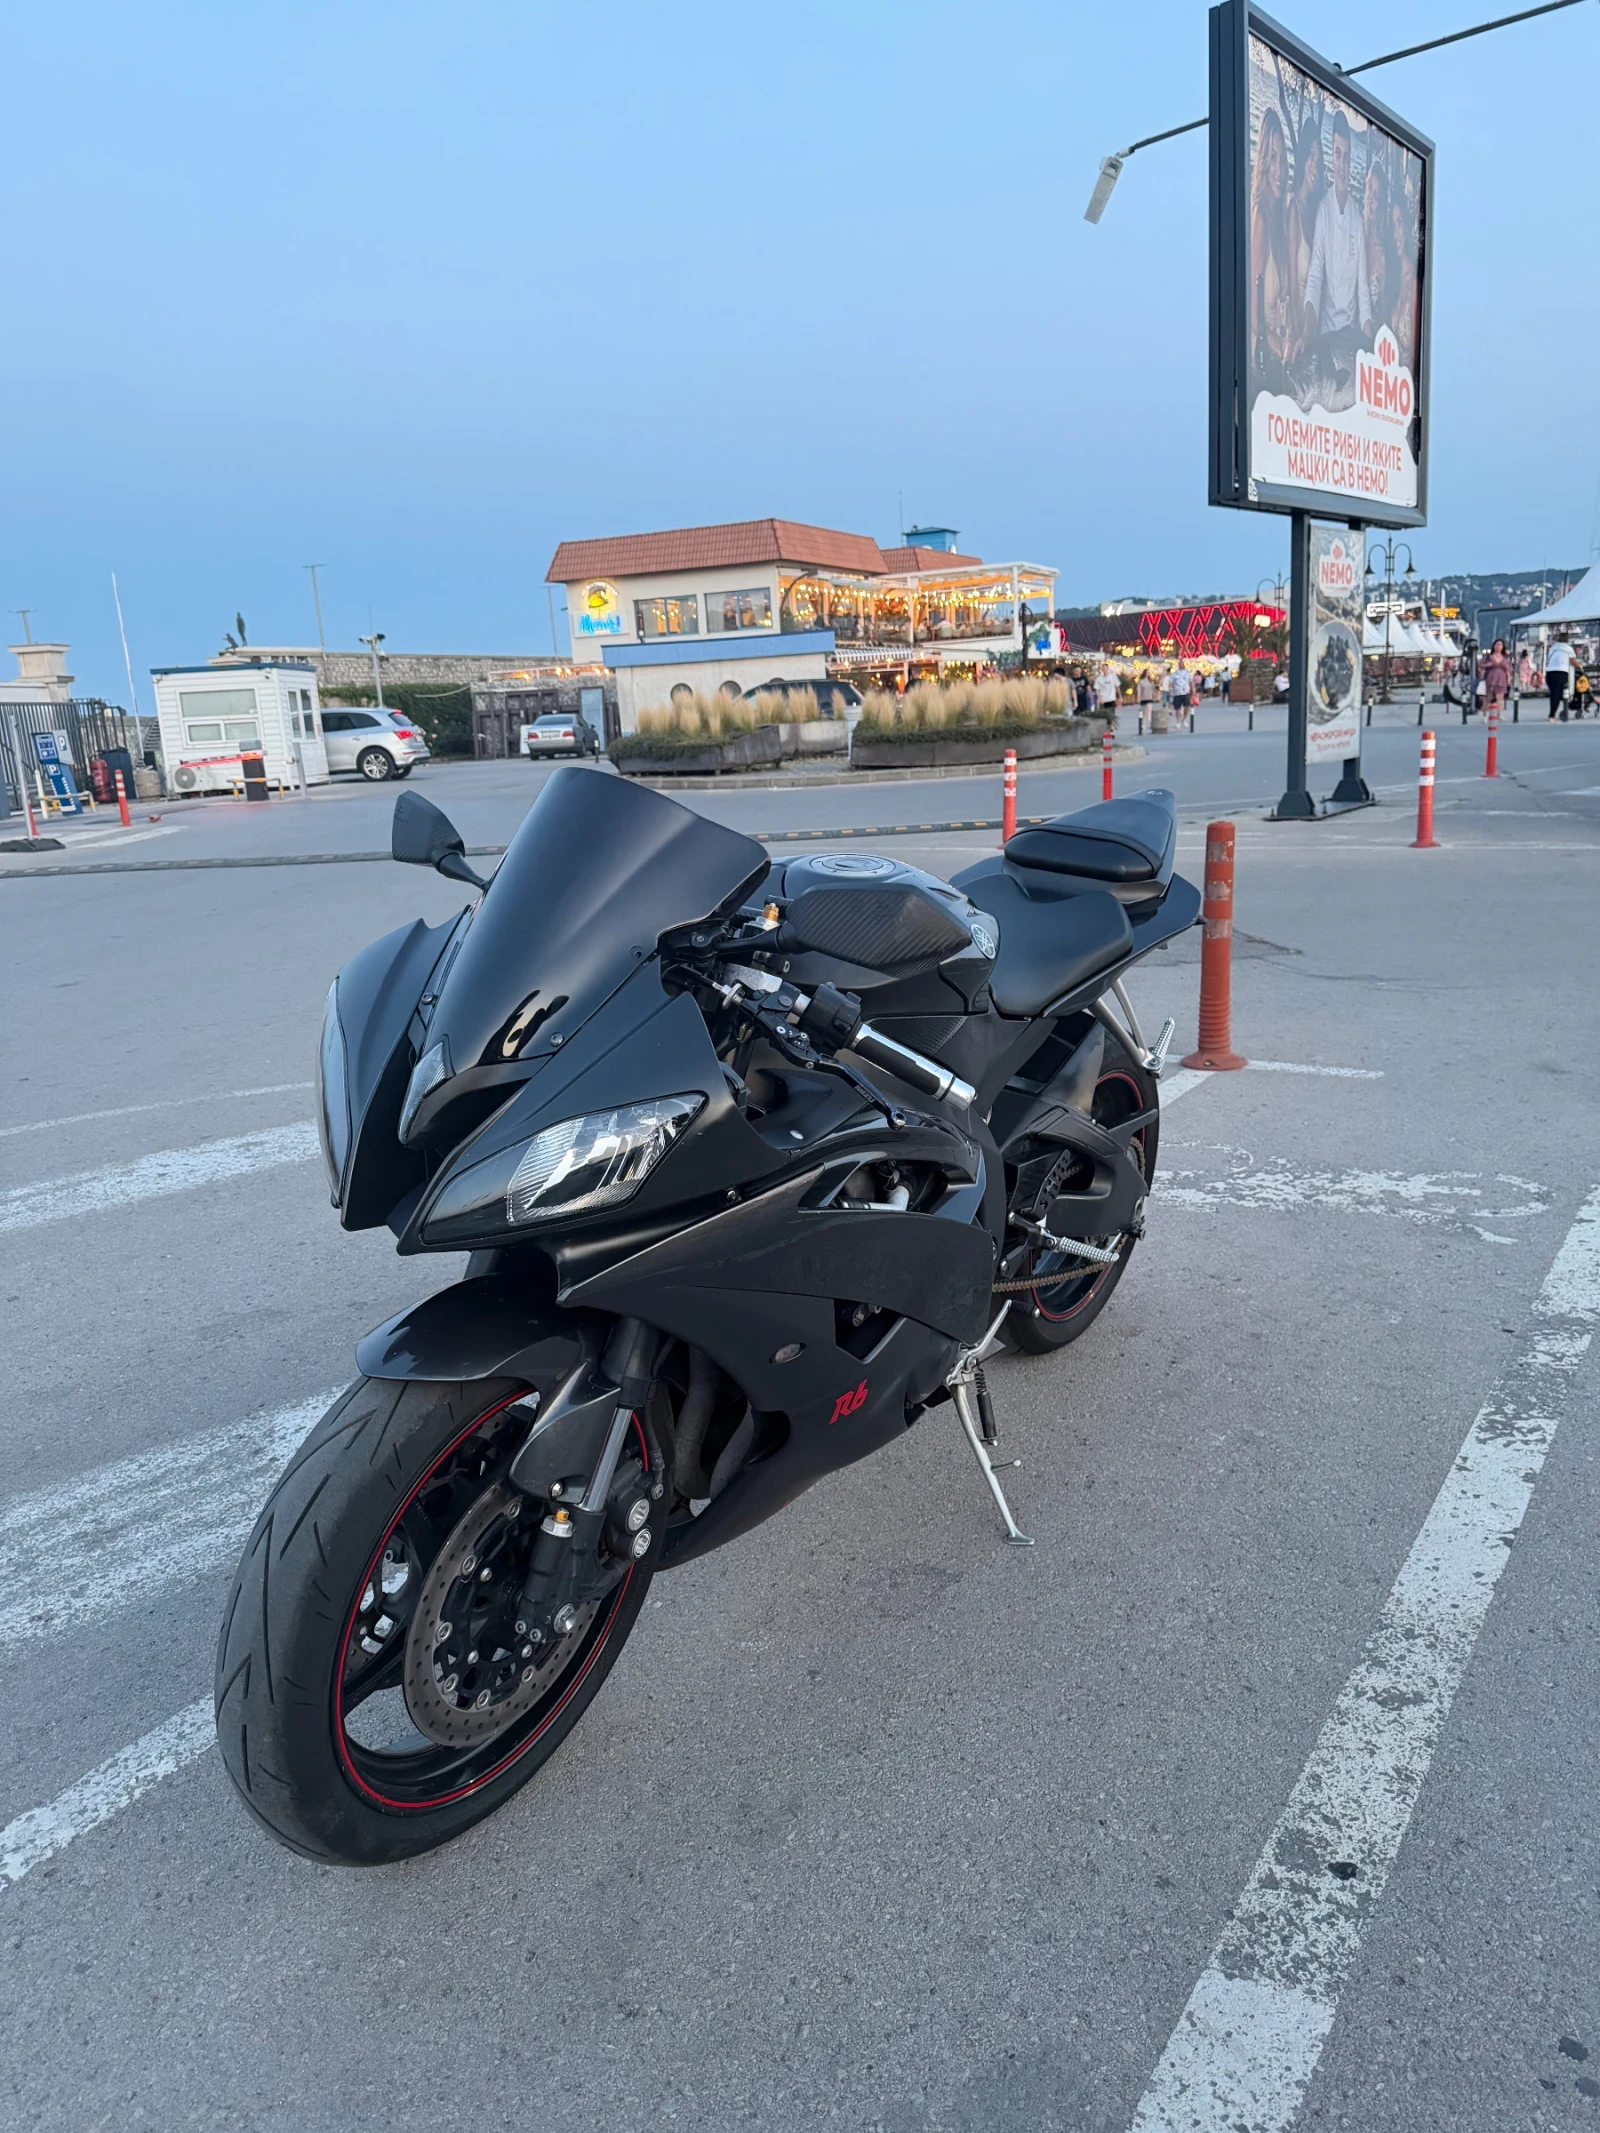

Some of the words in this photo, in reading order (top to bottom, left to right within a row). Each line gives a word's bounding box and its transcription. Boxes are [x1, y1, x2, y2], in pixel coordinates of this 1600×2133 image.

[1360, 362, 1410, 416] NEMO
[1268, 413, 1330, 455] ГОЛЕМИТЕ
[1333, 429, 1361, 462] РИБИ
[1363, 437, 1371, 463] И
[1372, 440, 1402, 472] ЯКИТЕ
[1287, 449, 1329, 486] МАЦКИ
[1331, 458, 1347, 487] СА
[1348, 462, 1355, 489] В
[1357, 464, 1389, 495] НЕМО!
[1321, 561, 1353, 585] NEMO
[59, 737, 66, 750] P
[49, 765, 57, 774] P
[829, 1378, 869, 1425] R6
